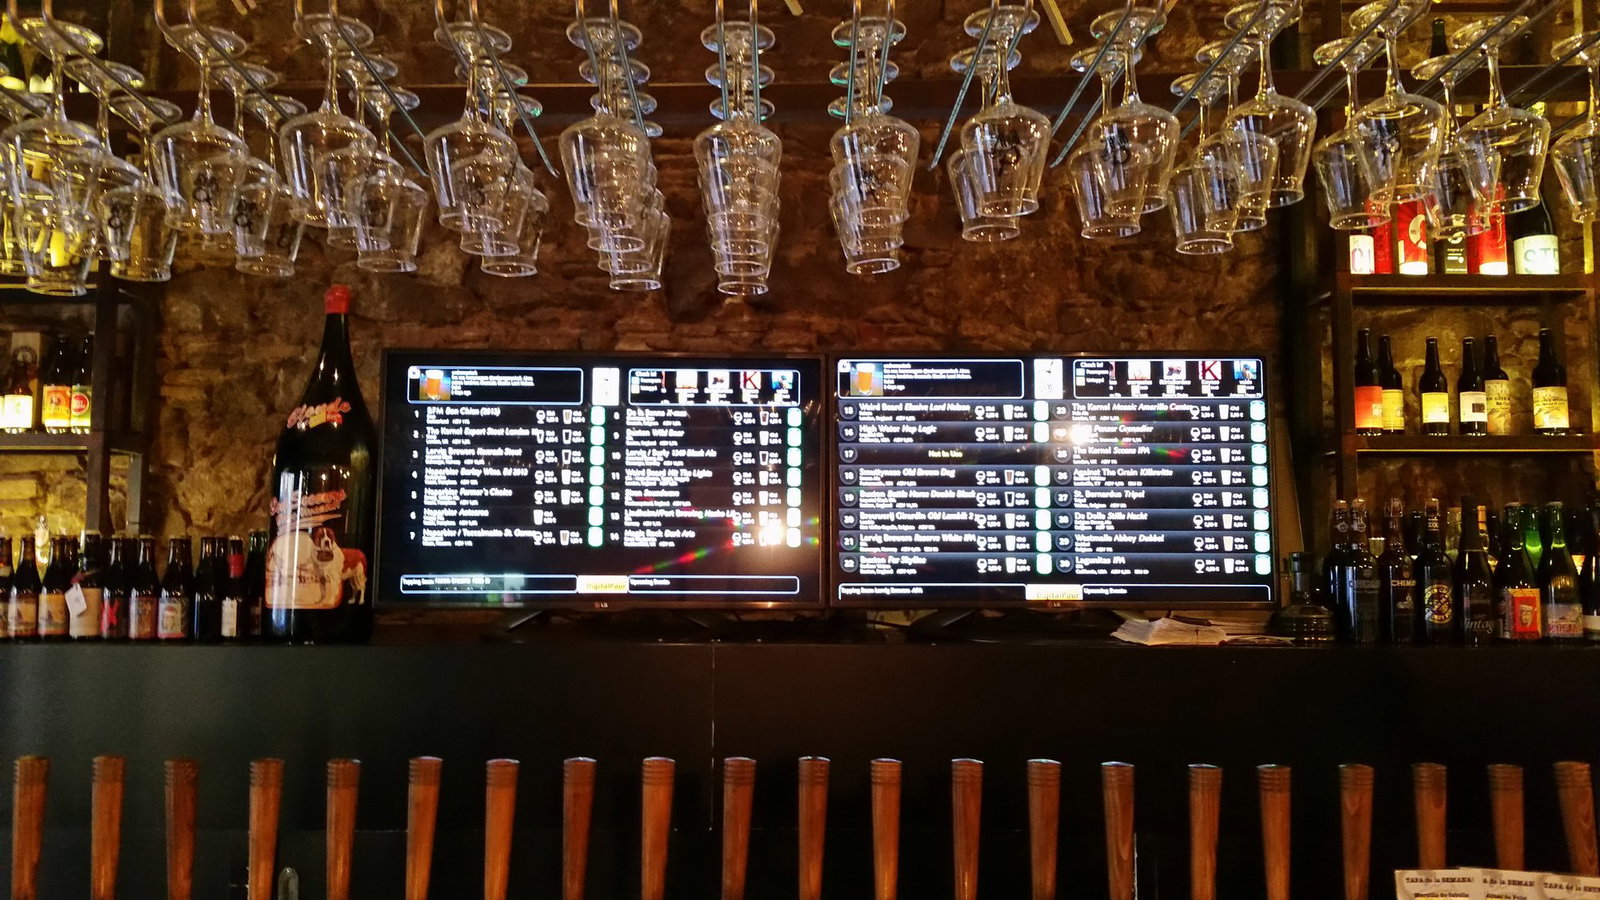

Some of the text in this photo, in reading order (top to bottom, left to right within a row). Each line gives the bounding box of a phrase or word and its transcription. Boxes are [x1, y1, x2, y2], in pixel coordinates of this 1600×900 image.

[426, 427, 439, 435] The
[440, 427, 462, 435] Kernel
[1074, 469, 1101, 477] Against
[1124, 490, 1144, 500] Tripel
[1114, 535, 1136, 543] Abbey
[1076, 557, 1111, 565] Lagunitas
